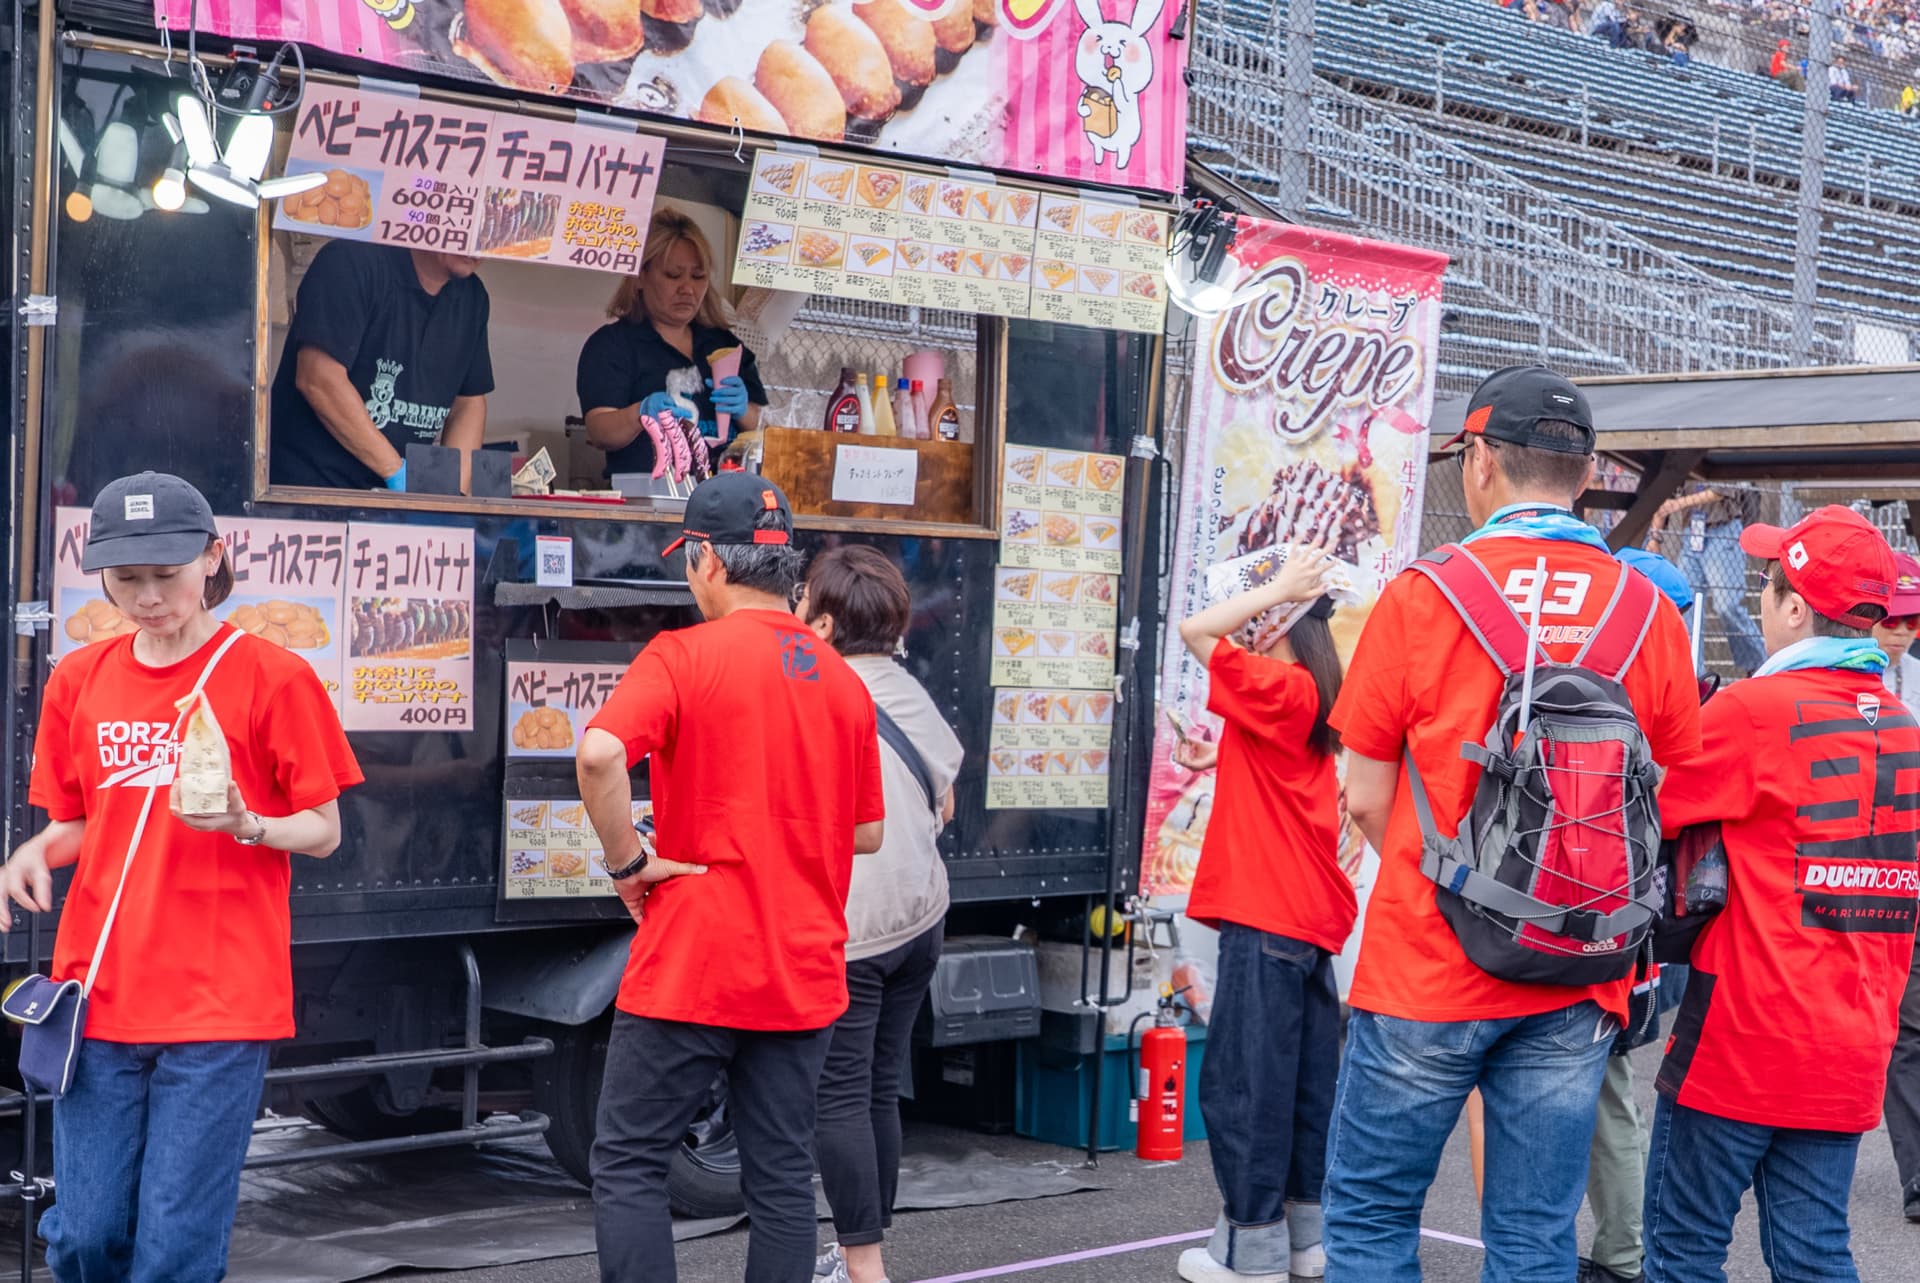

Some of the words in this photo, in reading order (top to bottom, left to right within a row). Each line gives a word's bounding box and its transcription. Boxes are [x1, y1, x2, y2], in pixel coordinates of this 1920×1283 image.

[299, 100, 488, 178] ベビーカステラ
[496, 130, 655, 199] チョコバナナ
[391, 188, 476, 216] 600円
[415, 178, 479, 198] 20個入り
[408, 209, 472, 230] 40個入り
[567, 202, 626, 221] お祭りで
[380, 220, 469, 251] 1200円
[564, 217, 638, 237] おなじみの
[562, 231, 641, 252] チョコバナナ
[568, 249, 637, 273] 400円
[1318, 286, 1416, 330] クレープ
[1214, 258, 1420, 440] Crepe
[226, 529, 342, 586] ビーカステラ
[353, 538, 471, 593] チョコバナナ
[1503, 568, 1592, 616] 93
[352, 679, 458, 692] おなじみの
[353, 666, 434, 680] お祭りで
[511, 669, 624, 709] ベビーカステ
[401, 708, 467, 725] 400円
